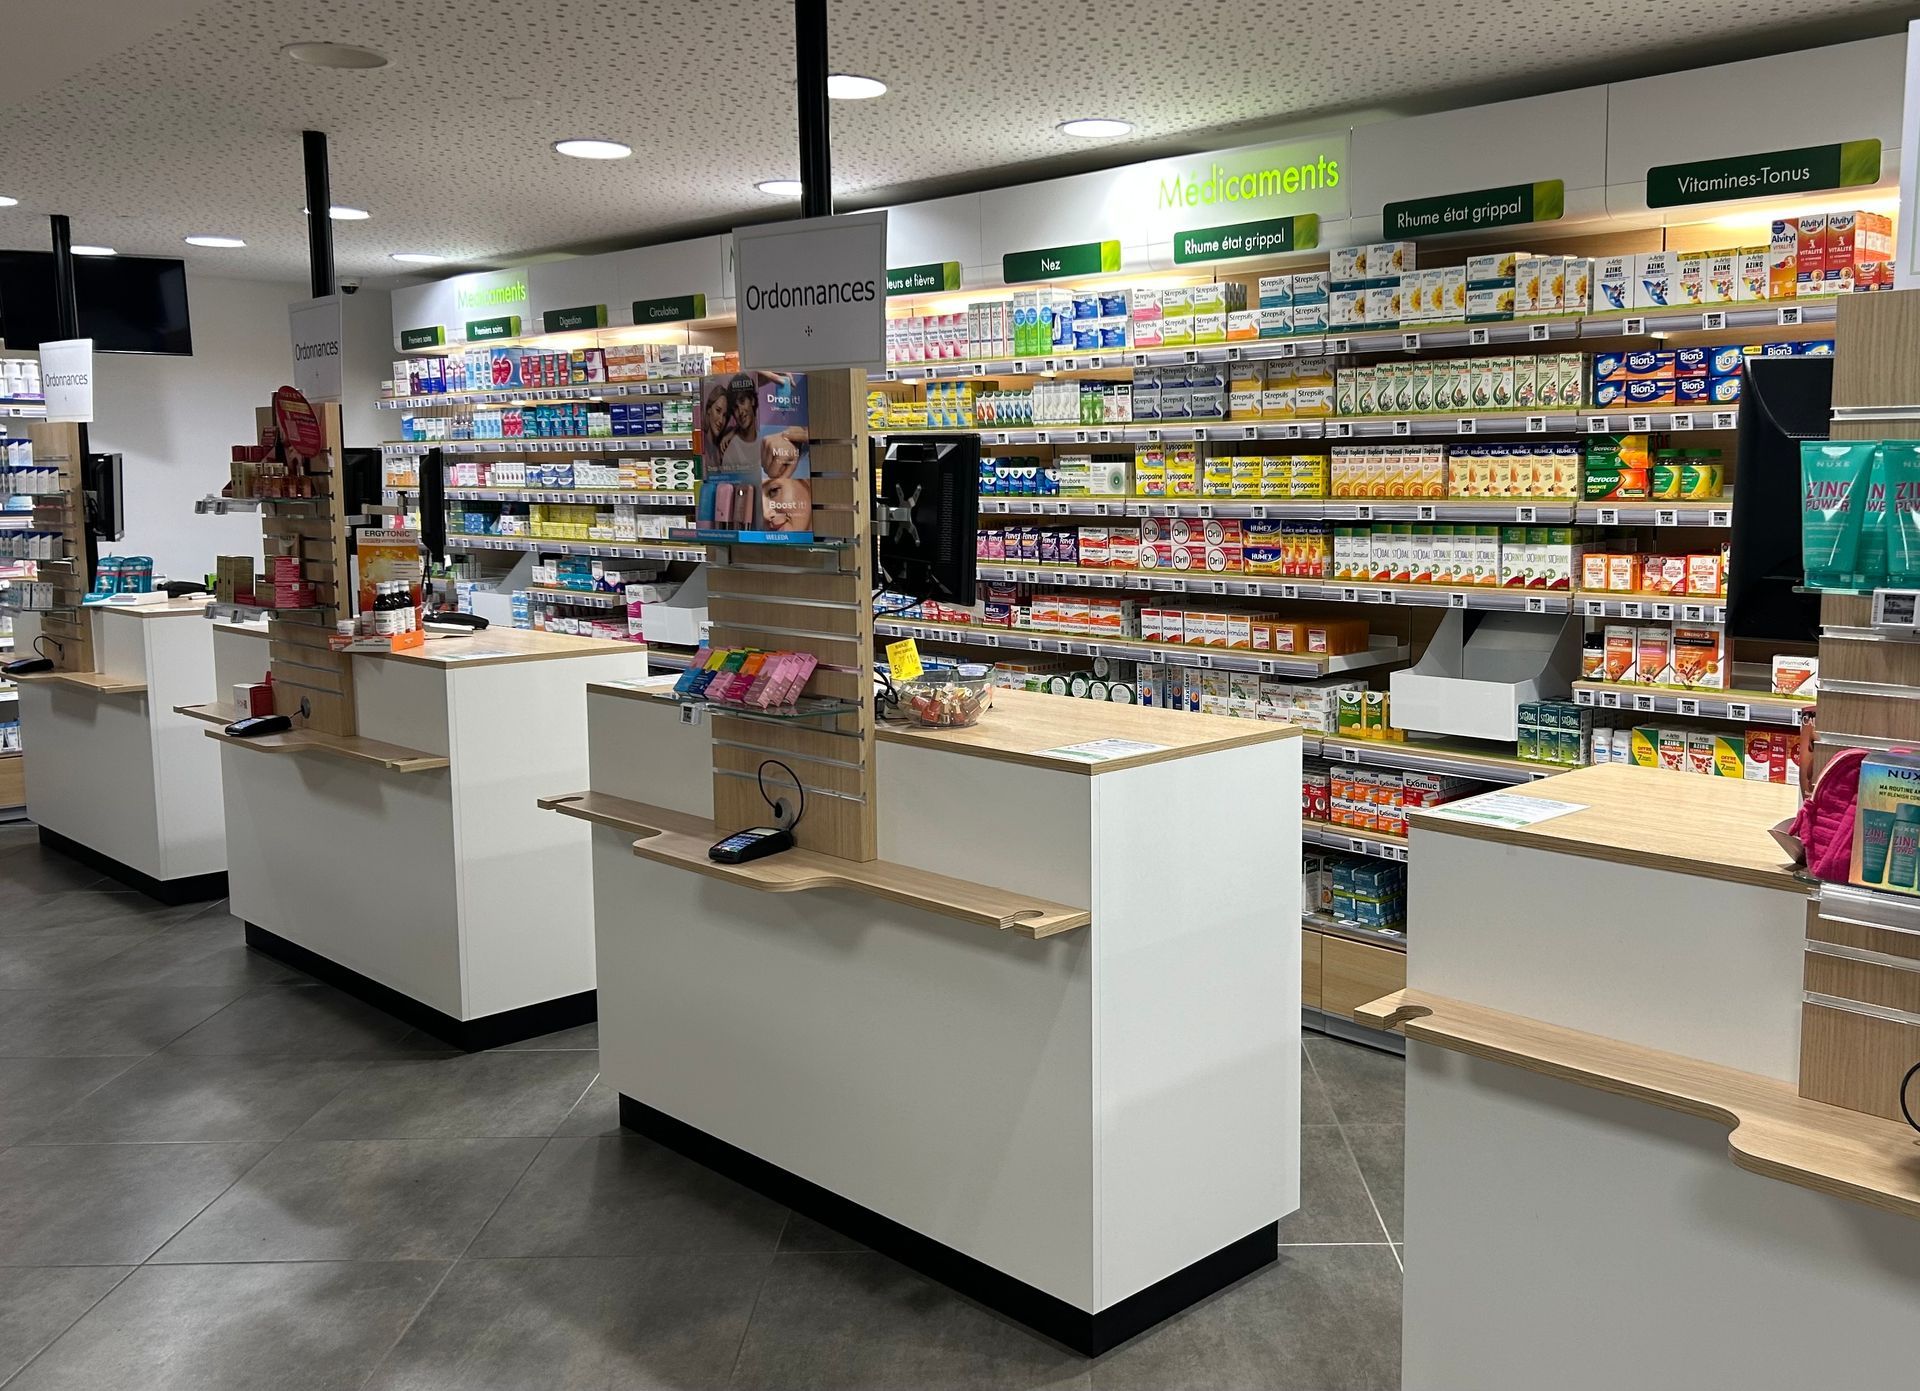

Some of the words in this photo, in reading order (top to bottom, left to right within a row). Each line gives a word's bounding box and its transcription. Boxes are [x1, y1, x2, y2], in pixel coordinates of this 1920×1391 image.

[1158, 155, 1340, 209] Médicaments
[1677, 165, 1810, 194] Vitamines-Tonus
[1397, 209, 1441, 230] Rhume
[1443, 203, 1470, 224] état
[1472, 196, 1523, 223] grippal
[1800, 218, 1824, 228] Alvityl
[1830, 215, 1854, 226] Alvityl
[1184, 239, 1219, 255] Rhume
[1222, 236, 1242, 251] état
[1244, 227, 1285, 251] grippal
[1772, 233, 1796, 243] Alvityl
[1800, 247, 1823, 255] VITALITÉ
[1828, 244, 1852, 253] VITALITÉ
[1041, 258, 1061, 272] Nez
[1647, 262, 1665, 270] AZINC
[1713, 264, 1730, 272] AZINC
[905, 276, 913, 287] et
[914, 274, 935, 286] fièvre
[1260, 278, 1285, 287] Strepsils
[1294, 274, 1320, 284] Strepsils
[746, 280, 875, 311] Ordonnances
[649, 305, 680, 318] Circulation
[1261, 309, 1286, 318] Strepsils
[1295, 306, 1320, 316] Strepsils
[559, 316, 582, 328] Digestion
[474, 326, 492, 336] Premiers
[492, 325, 504, 334] soins
[423, 335, 432, 343] soins
[295, 339, 339, 361] Ordonnances
[1768, 346, 1792, 356] Bion3
[1300, 357, 1327, 367] Strepsils
[1630, 355, 1655, 366] Bion3
[1680, 352, 1704, 362] Bion3
[1716, 354, 1742, 366] Bion3
[1268, 360, 1294, 369] Strepsils
[1162, 365, 1187, 375] Strepsils
[45, 372, 88, 388] Ordonnances
[1682, 380, 1704, 390] Bion3
[1298, 388, 1324, 398] Strepsils
[1630, 384, 1656, 394] Bion3
[767, 394, 791, 406] Drop
[1230, 392, 1254, 402] Strepsils
[1264, 390, 1290, 400] Strepsils
[772, 447, 789, 457] Mix
[1806, 481, 1850, 500] ZINC
[769, 501, 797, 510] Boost
[1805, 499, 1850, 513] POWER
[364, 530, 411, 538] ERGYTONIC
[1144, 527, 1158, 536] Drill
[1174, 528, 1188, 537] Drill
[1208, 528, 1222, 538] Drill
[1142, 554, 1156, 562] Drill
[1175, 554, 1188, 563] Drill
[1210, 556, 1224, 566] Drill
[1251, 553, 1273, 561] HUMEX
[1406, 778, 1438, 790] Exomuc
[1888, 786, 1913, 794] ROUTINE
[1887, 792, 1910, 800] BLEMISH
